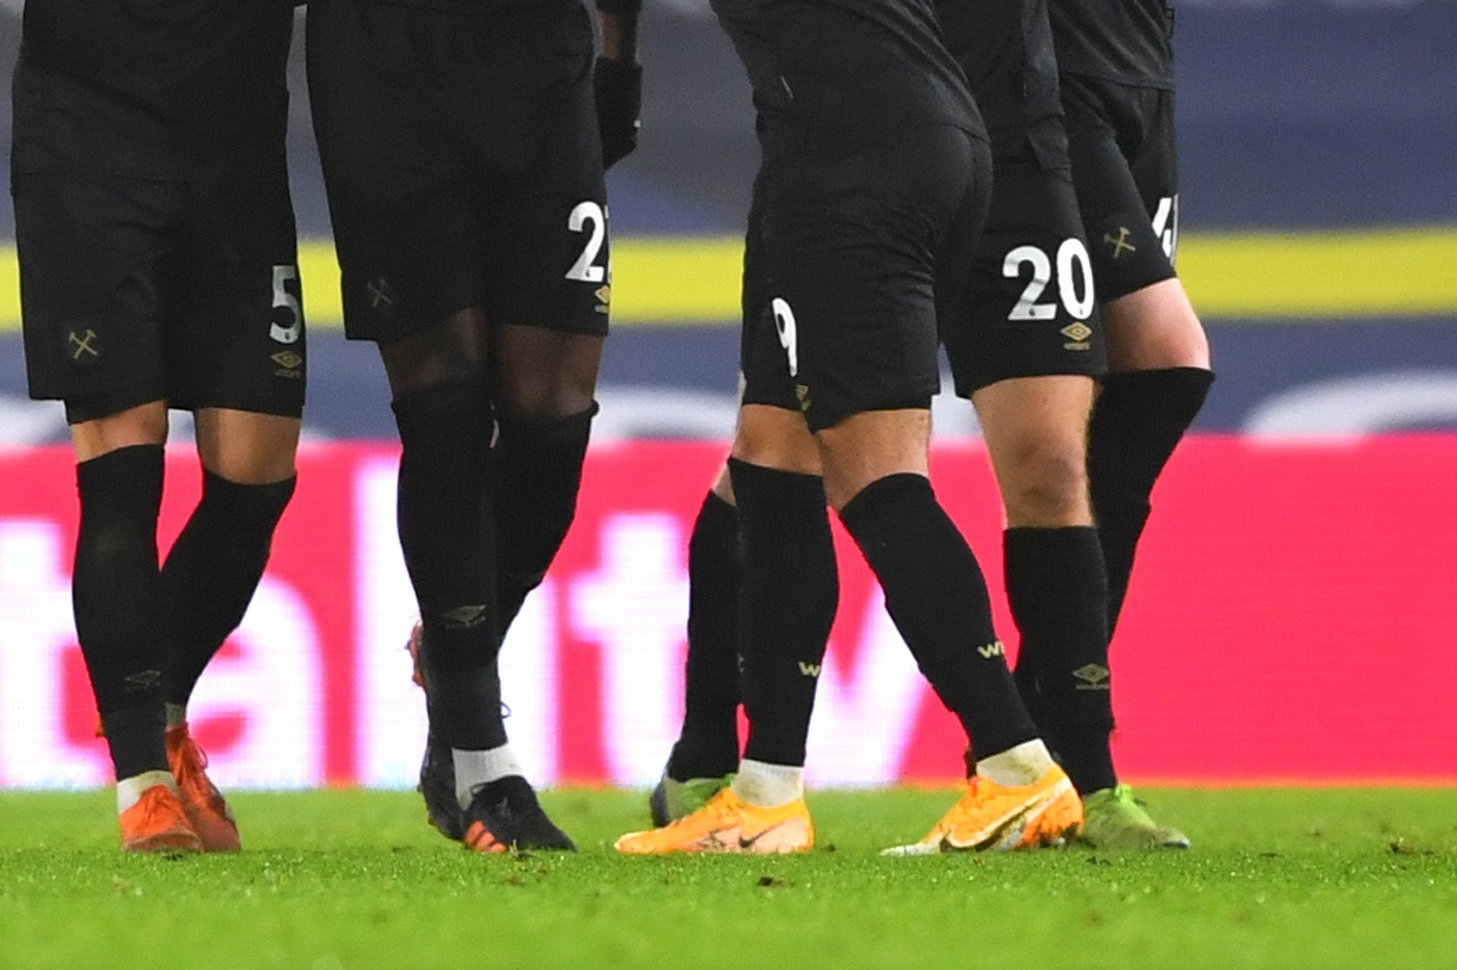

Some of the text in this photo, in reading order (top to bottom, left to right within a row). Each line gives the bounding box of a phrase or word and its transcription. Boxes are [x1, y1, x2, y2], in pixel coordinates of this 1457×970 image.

[565, 200, 610, 283] 2
[1002, 238, 1095, 321] 20
[269, 265, 302, 345] 5
[772, 297, 798, 378] 9
